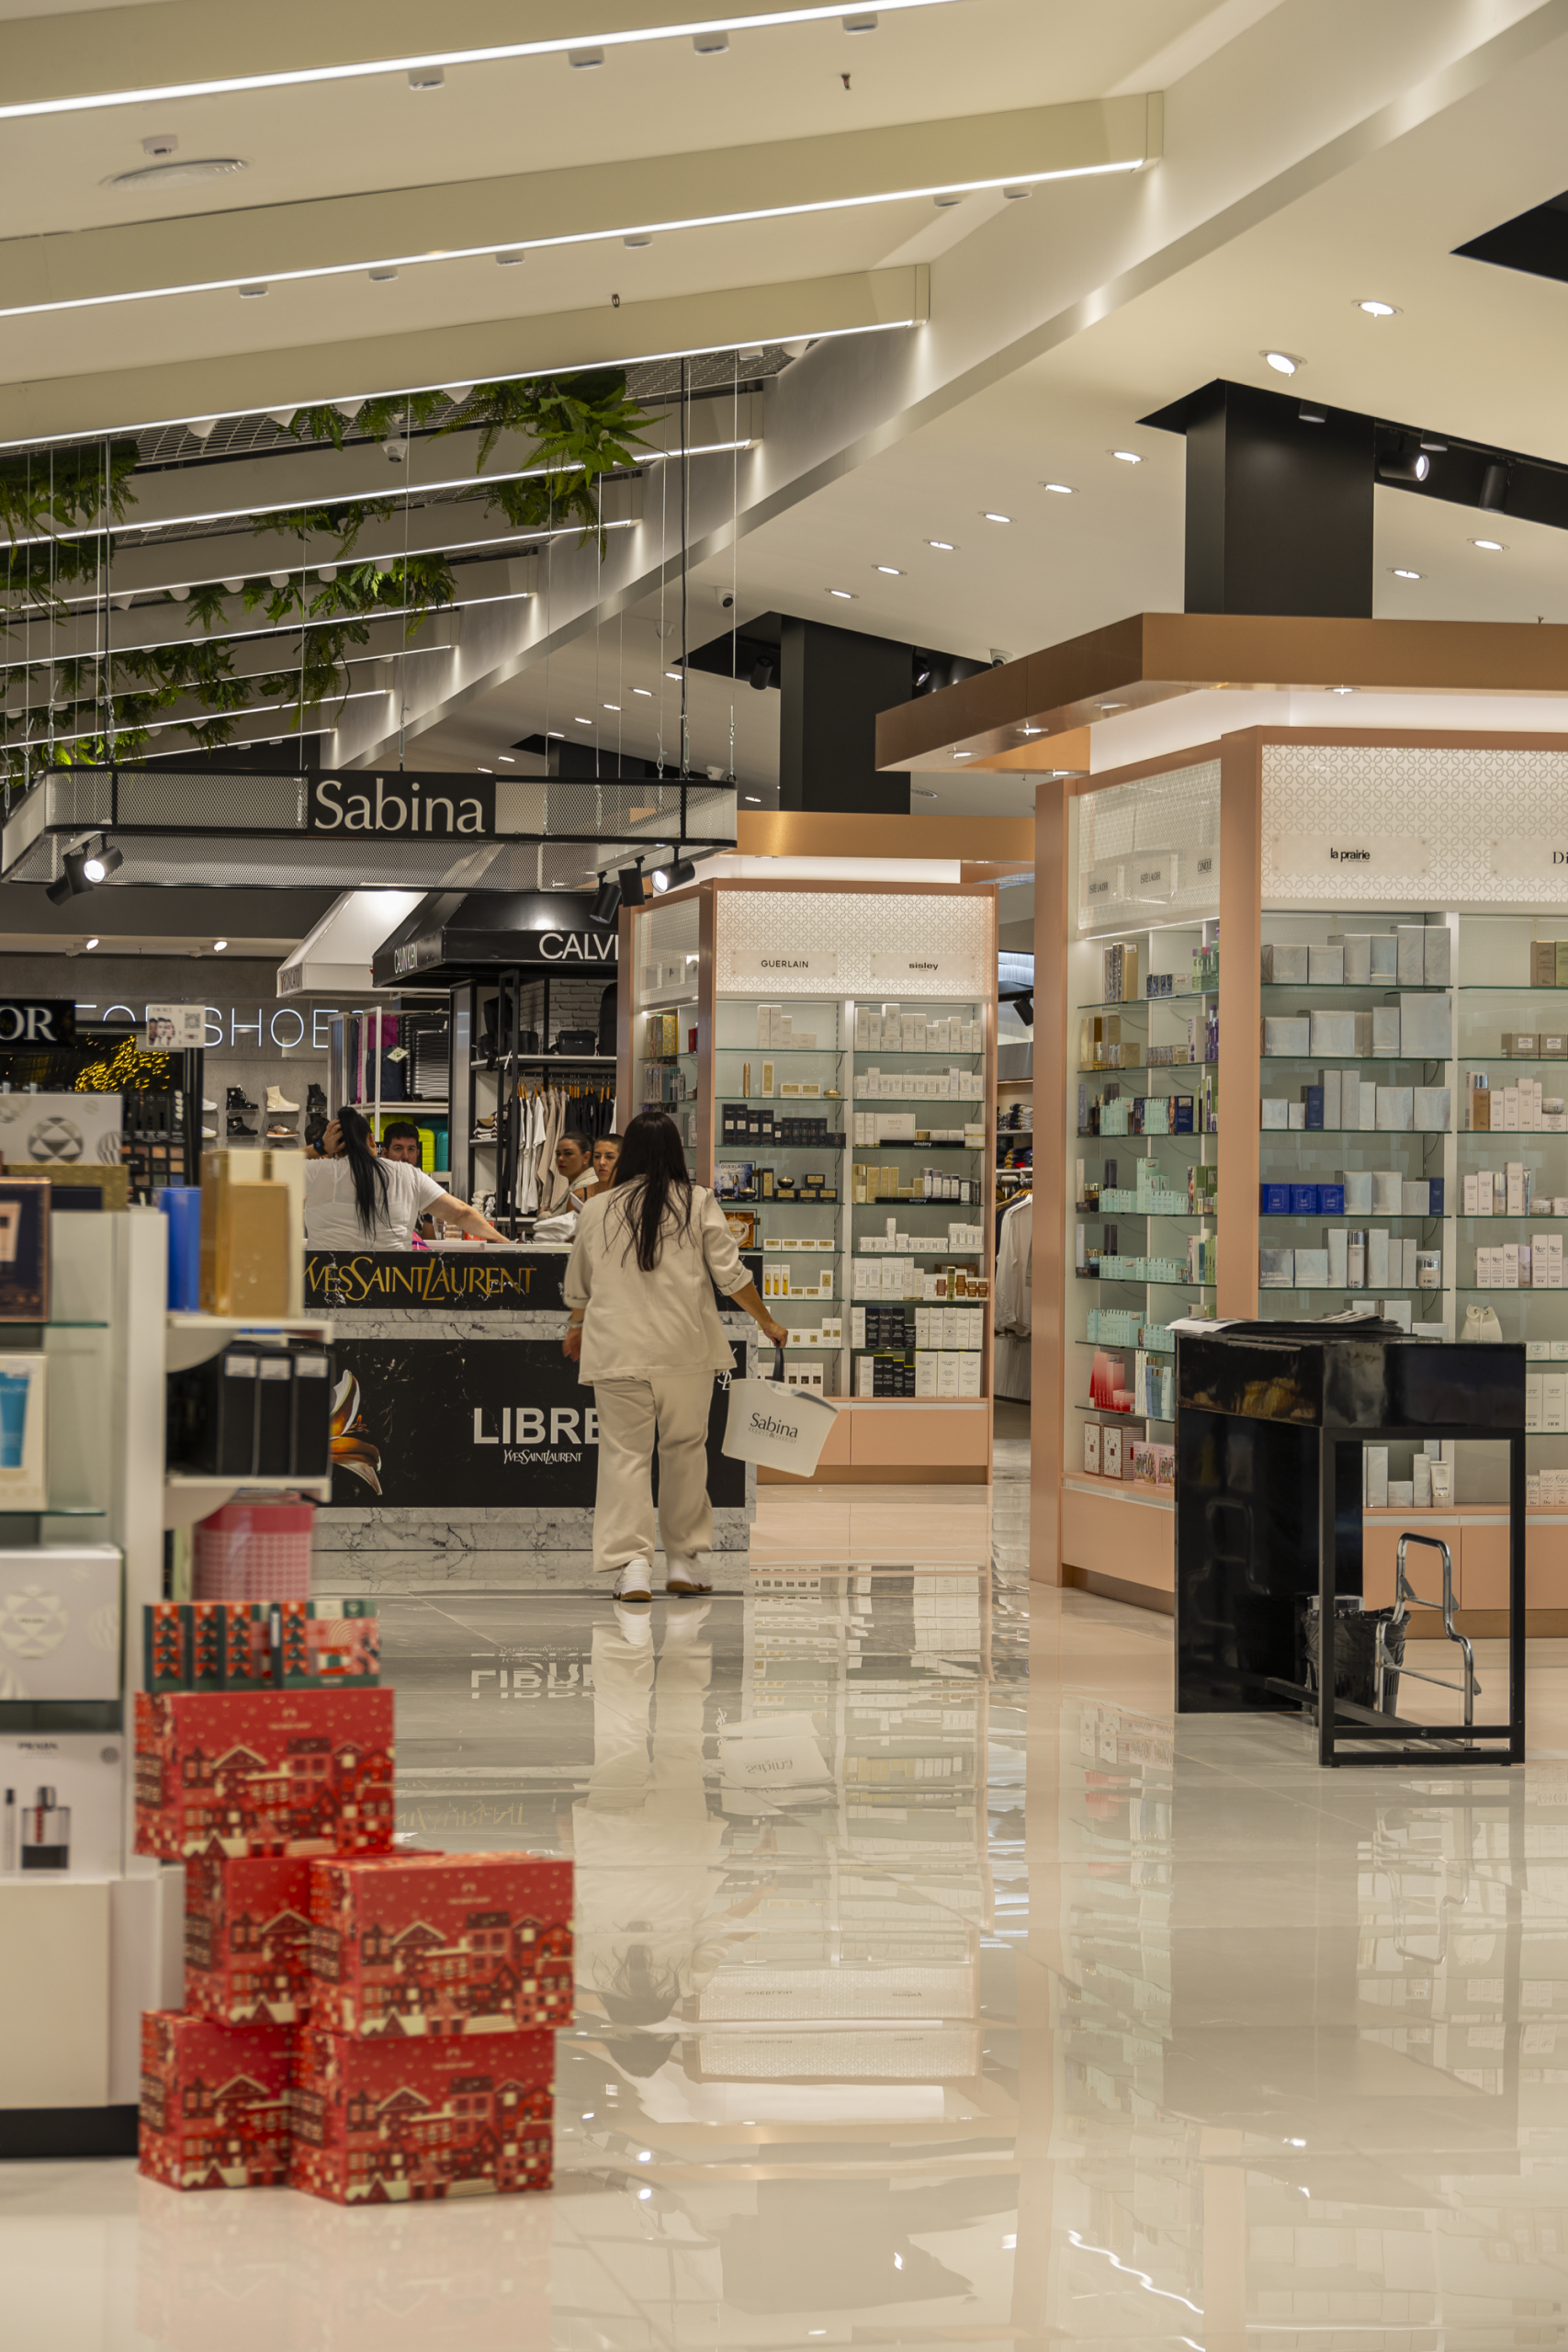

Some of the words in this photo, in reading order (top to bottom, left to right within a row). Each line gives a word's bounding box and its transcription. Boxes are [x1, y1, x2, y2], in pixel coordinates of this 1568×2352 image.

[314, 777, 486, 833] Sabina
[1330, 847, 1338, 859] la
[1340, 849, 1371, 863] prairie
[761, 959, 809, 968] GUERLAIN
[908, 961, 939, 971] sisley
[204, 1006, 365, 1049] SHOE
[750, 1412, 798, 1438] Sabina
